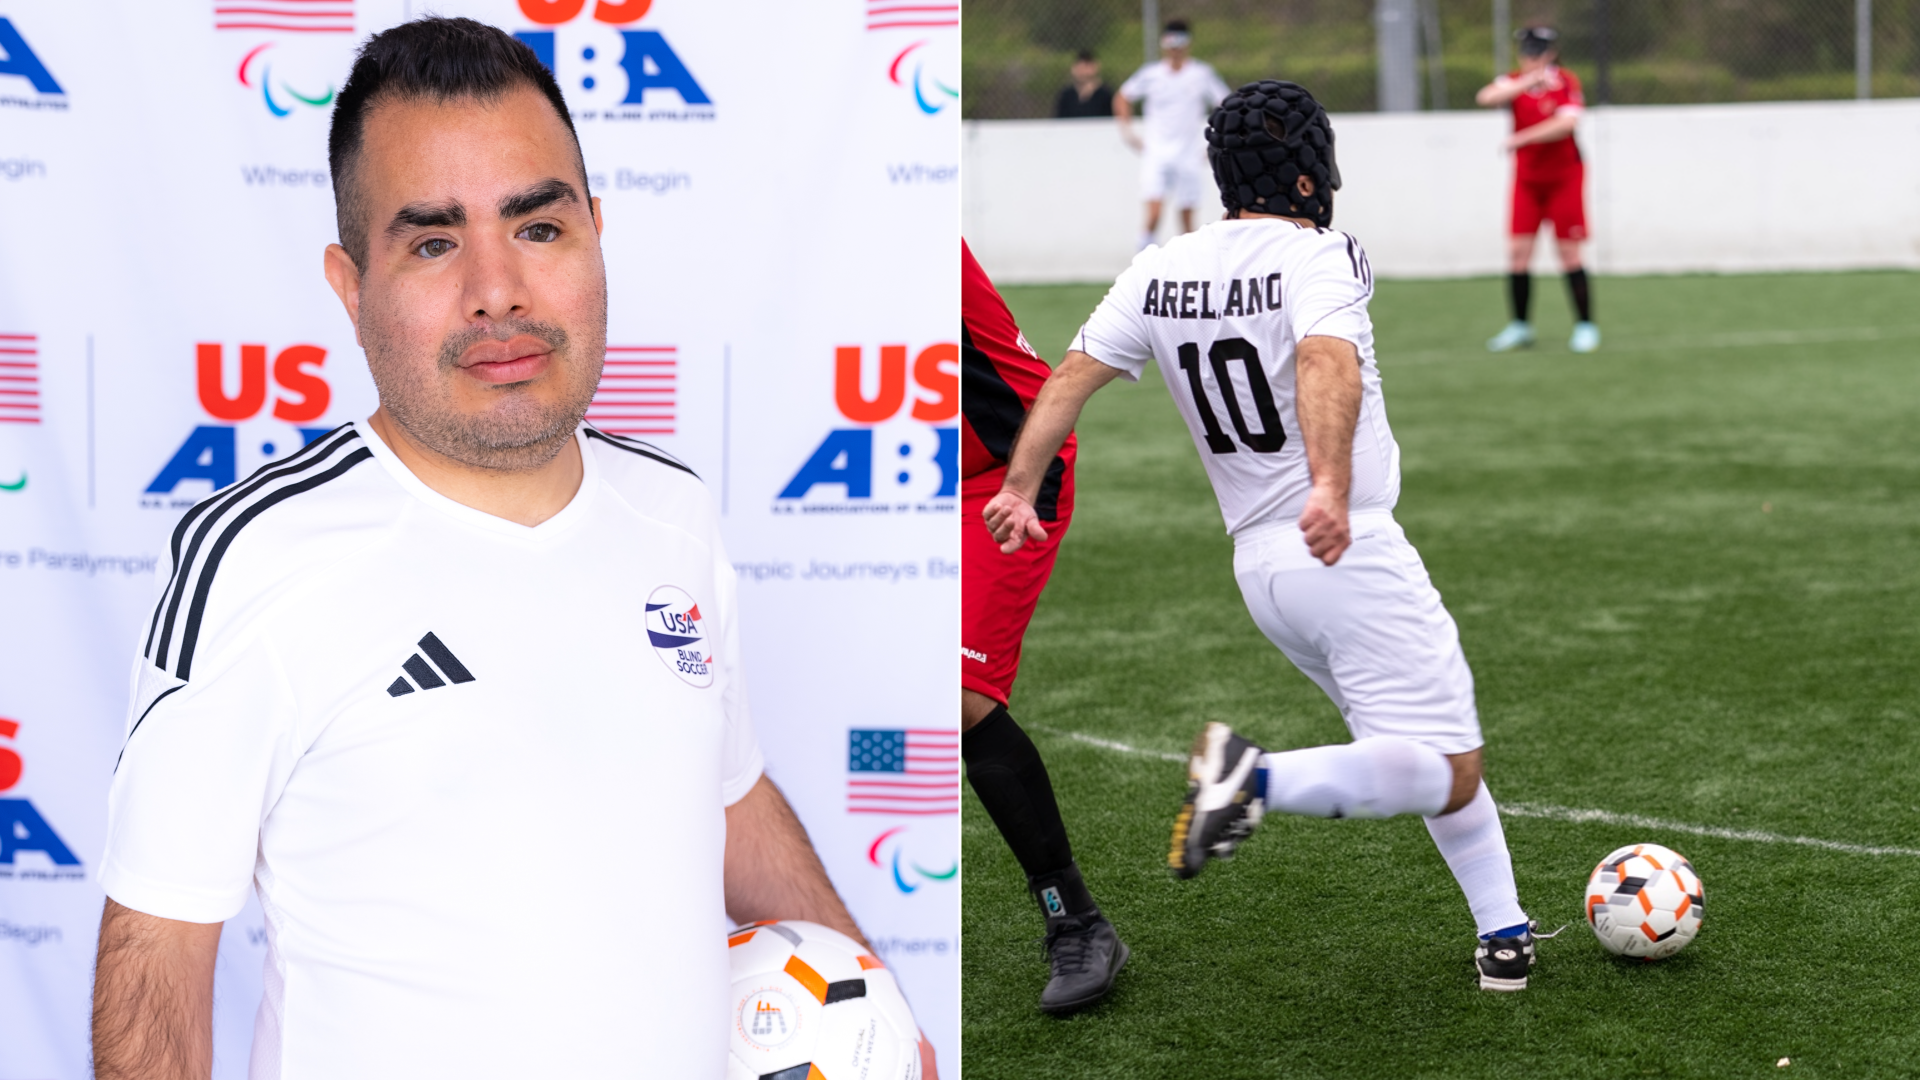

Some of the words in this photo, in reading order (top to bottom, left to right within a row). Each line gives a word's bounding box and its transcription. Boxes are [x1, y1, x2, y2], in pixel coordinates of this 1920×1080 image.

[242, 166, 328, 187] Where
[616, 169, 691, 193] Begin
[1142, 272, 1283, 321] ARELANO
[196, 342, 332, 423] US
[834, 342, 959, 424] US
[1177, 337, 1287, 455] 10
[801, 558, 919, 583] Journeys
[660, 610, 699, 634] USA
[677, 648, 703, 663] BLIND
[677, 660, 709, 675] SOCCER
